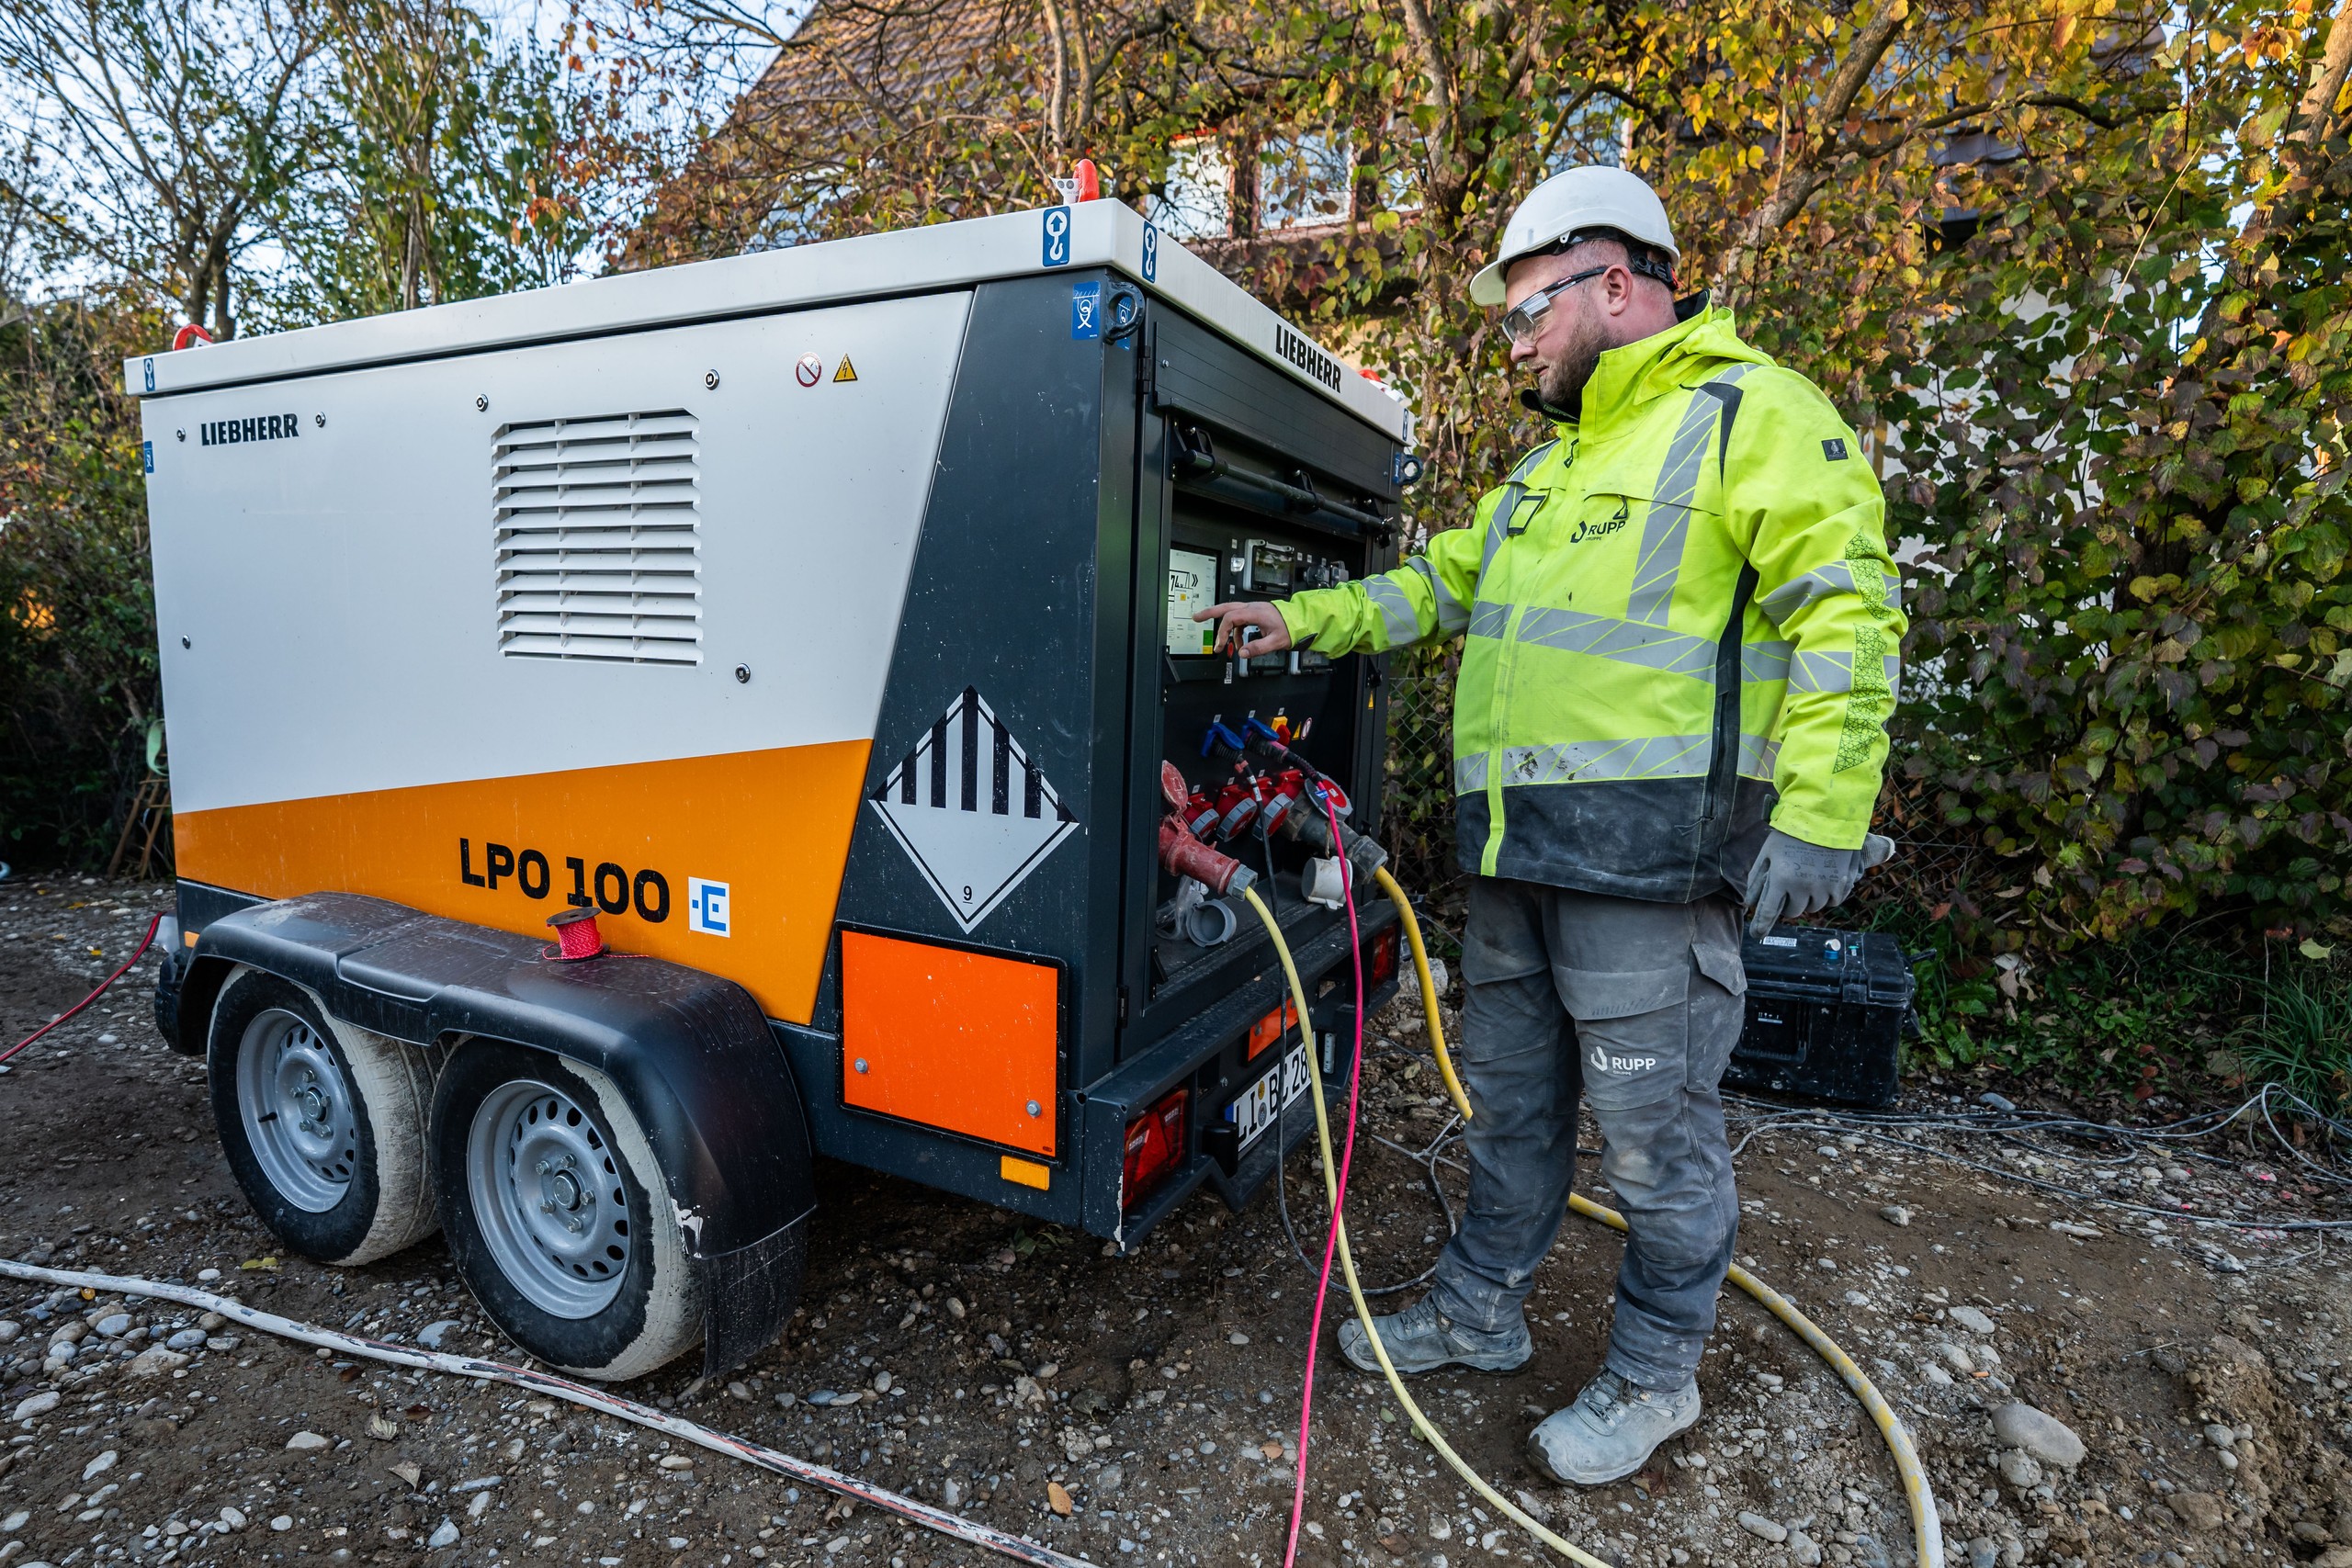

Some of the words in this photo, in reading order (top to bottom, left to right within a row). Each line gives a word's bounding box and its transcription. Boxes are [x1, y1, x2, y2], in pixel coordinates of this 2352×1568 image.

[1275, 323, 1340, 393] LIEBHERR
[200, 412, 300, 446] LIEBHERR
[1588, 521, 1626, 536] RUPP
[459, 837, 550, 900] LPO
[565, 855, 671, 924] 100
[963, 885, 974, 902] 9
[1292, 1045, 1311, 1095] 28
[1611, 1056, 1657, 1071] RUPP
